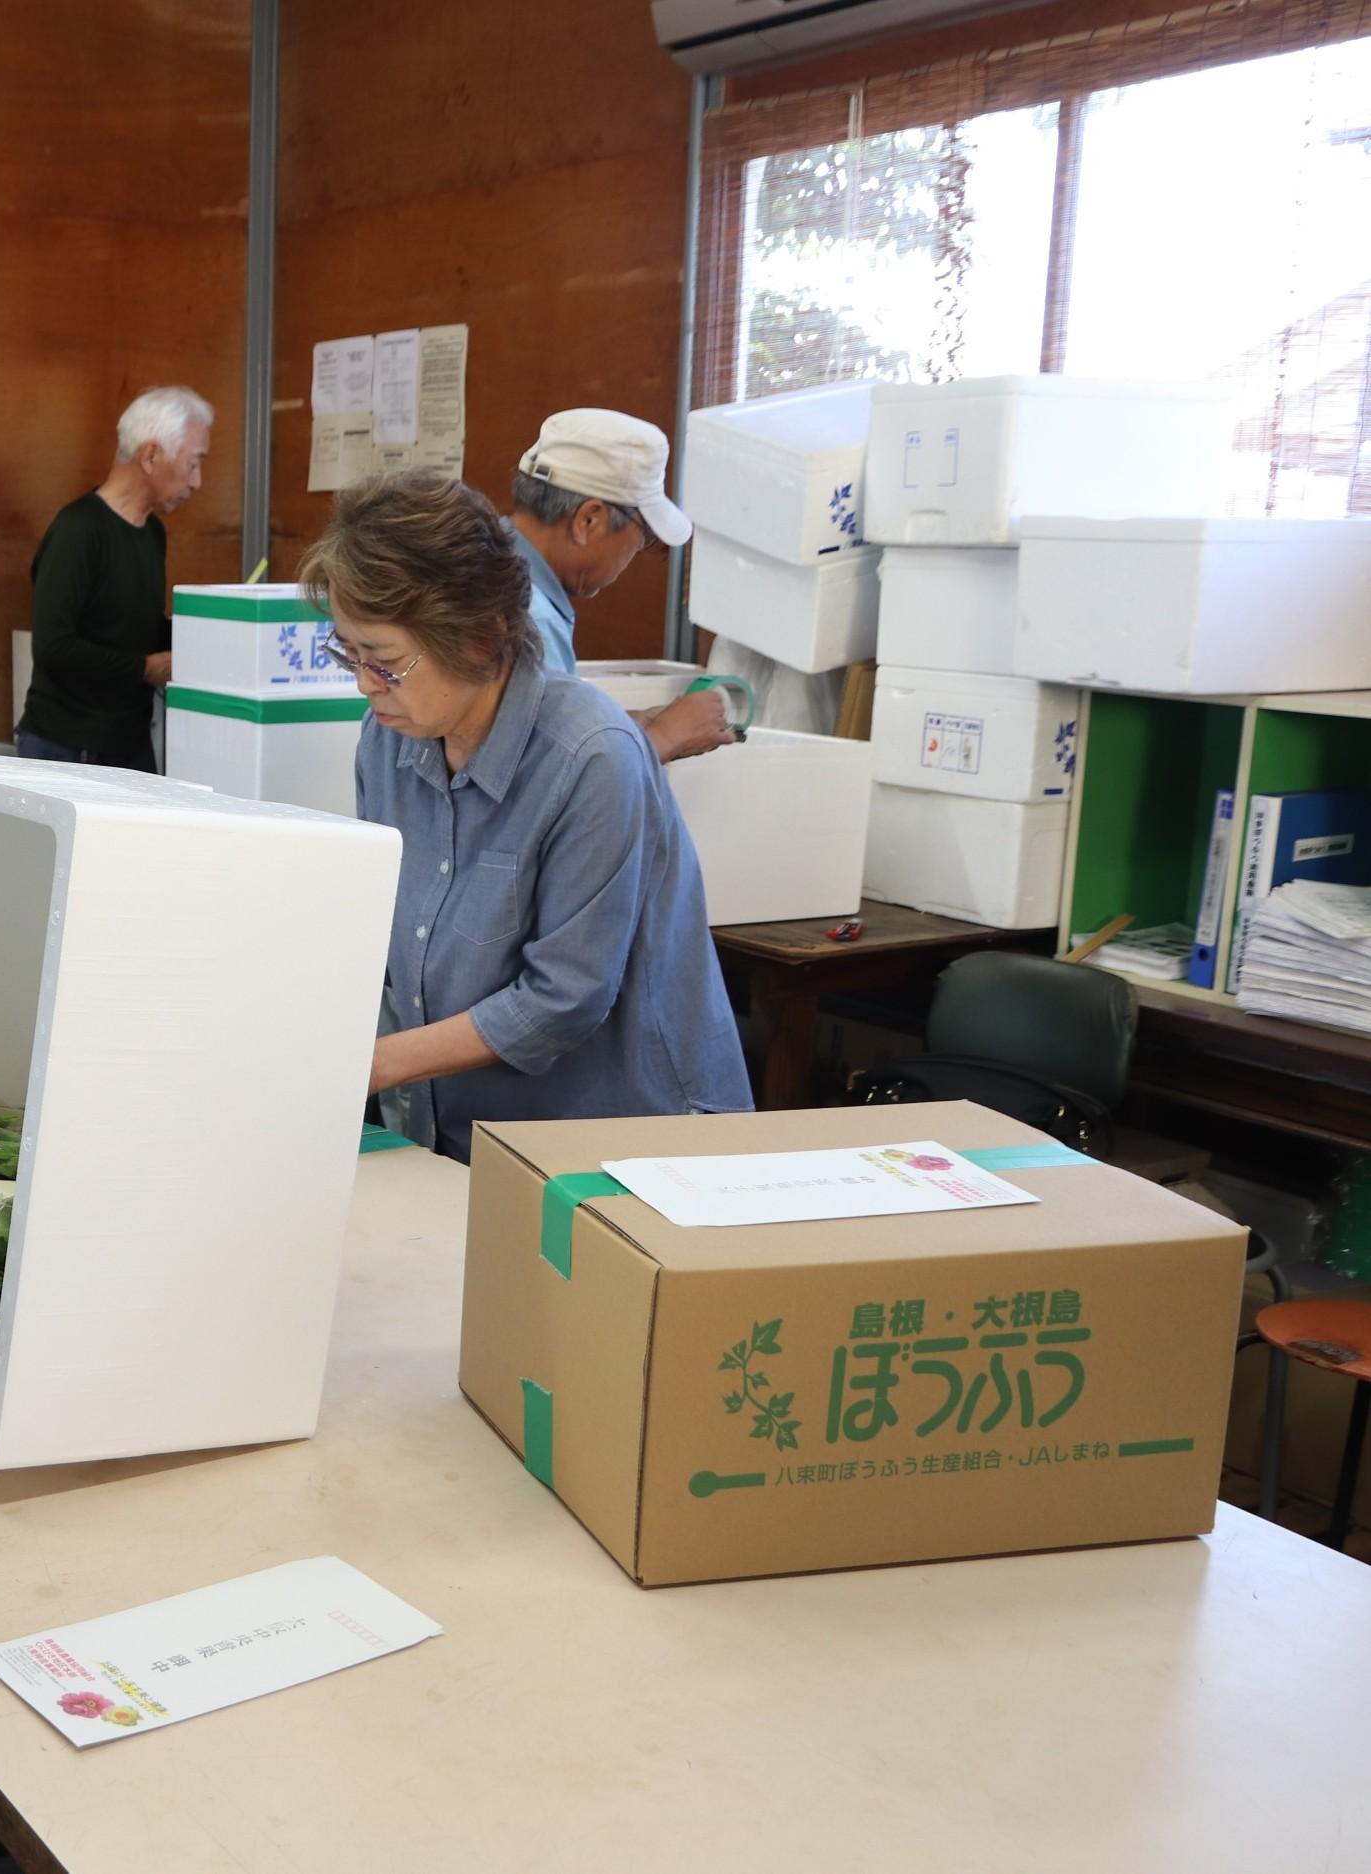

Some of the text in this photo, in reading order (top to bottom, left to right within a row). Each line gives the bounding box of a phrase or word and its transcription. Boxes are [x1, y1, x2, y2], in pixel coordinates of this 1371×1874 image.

[849, 1289, 1082, 1339] 島根・大根島
[825, 1327, 1092, 1444] ぼうふう
[774, 1441, 1111, 1486] 八束町ぼうふう生産組合・JAしまね
